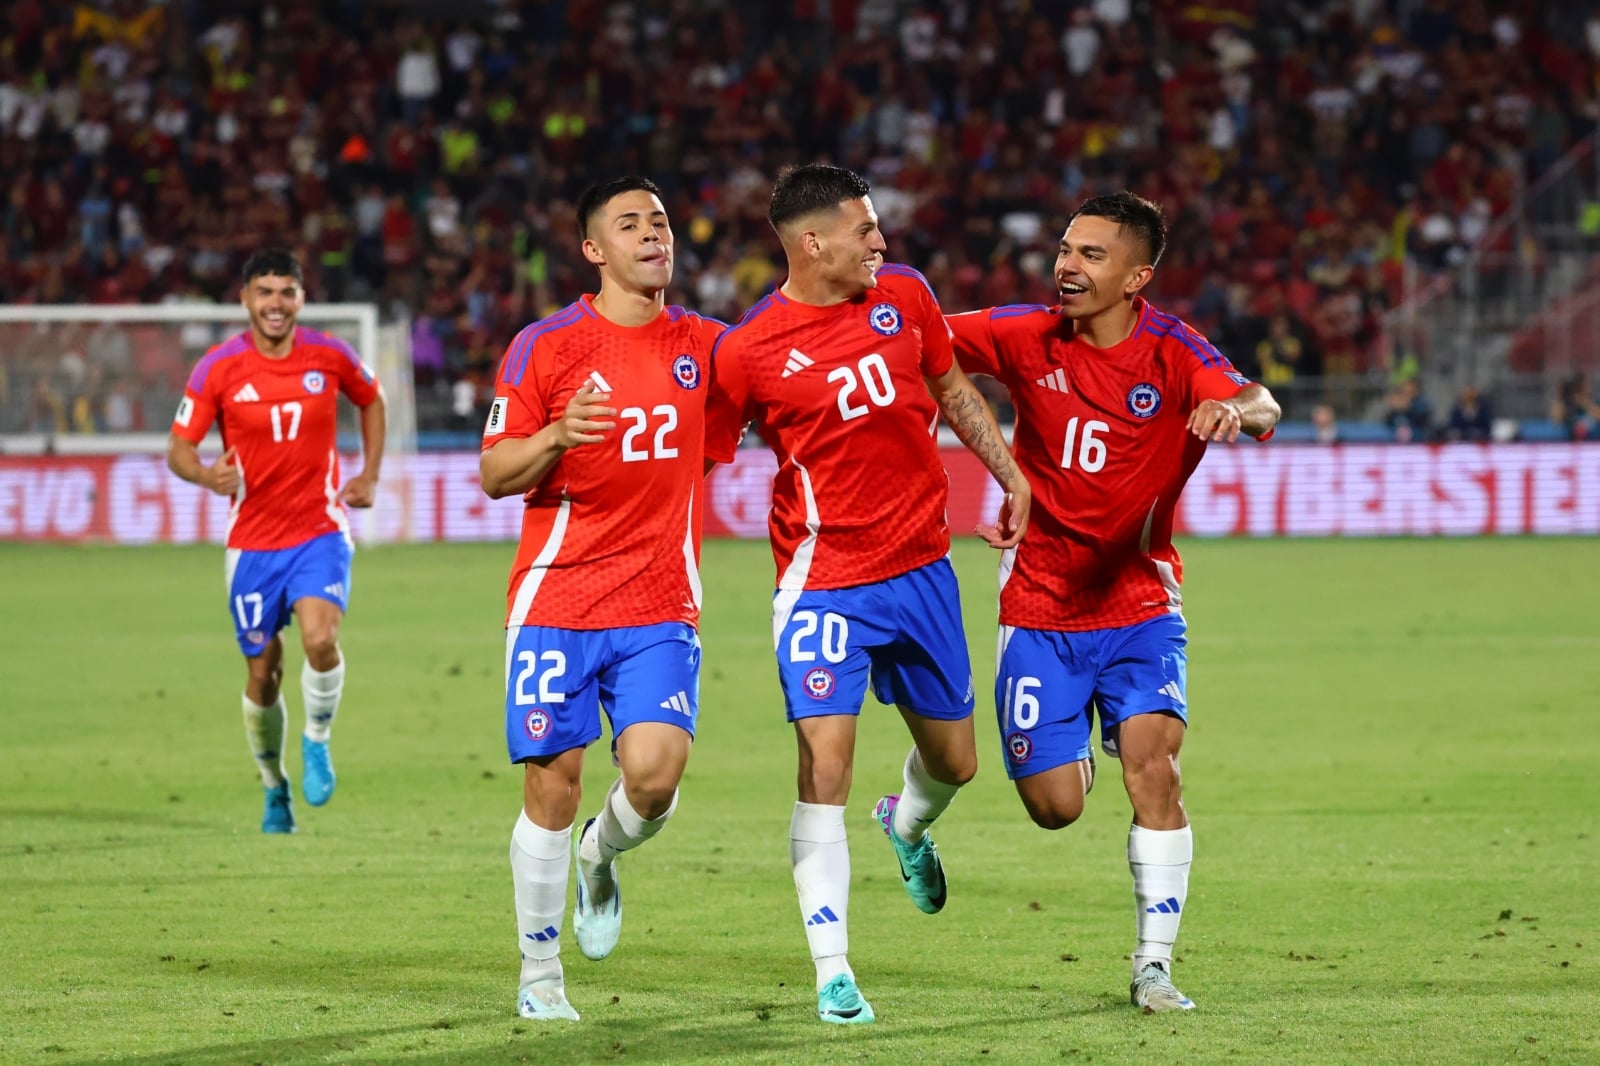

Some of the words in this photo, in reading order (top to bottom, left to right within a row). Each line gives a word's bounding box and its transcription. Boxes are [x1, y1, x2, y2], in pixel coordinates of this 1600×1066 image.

[827, 353, 896, 421] 20
[270, 402, 303, 442] 17
[620, 405, 679, 462] 22
[1060, 417, 1109, 473] 16
[235, 592, 263, 630] 17
[789, 611, 849, 664] 20
[515, 650, 567, 706] 22
[1004, 676, 1041, 730] 16
